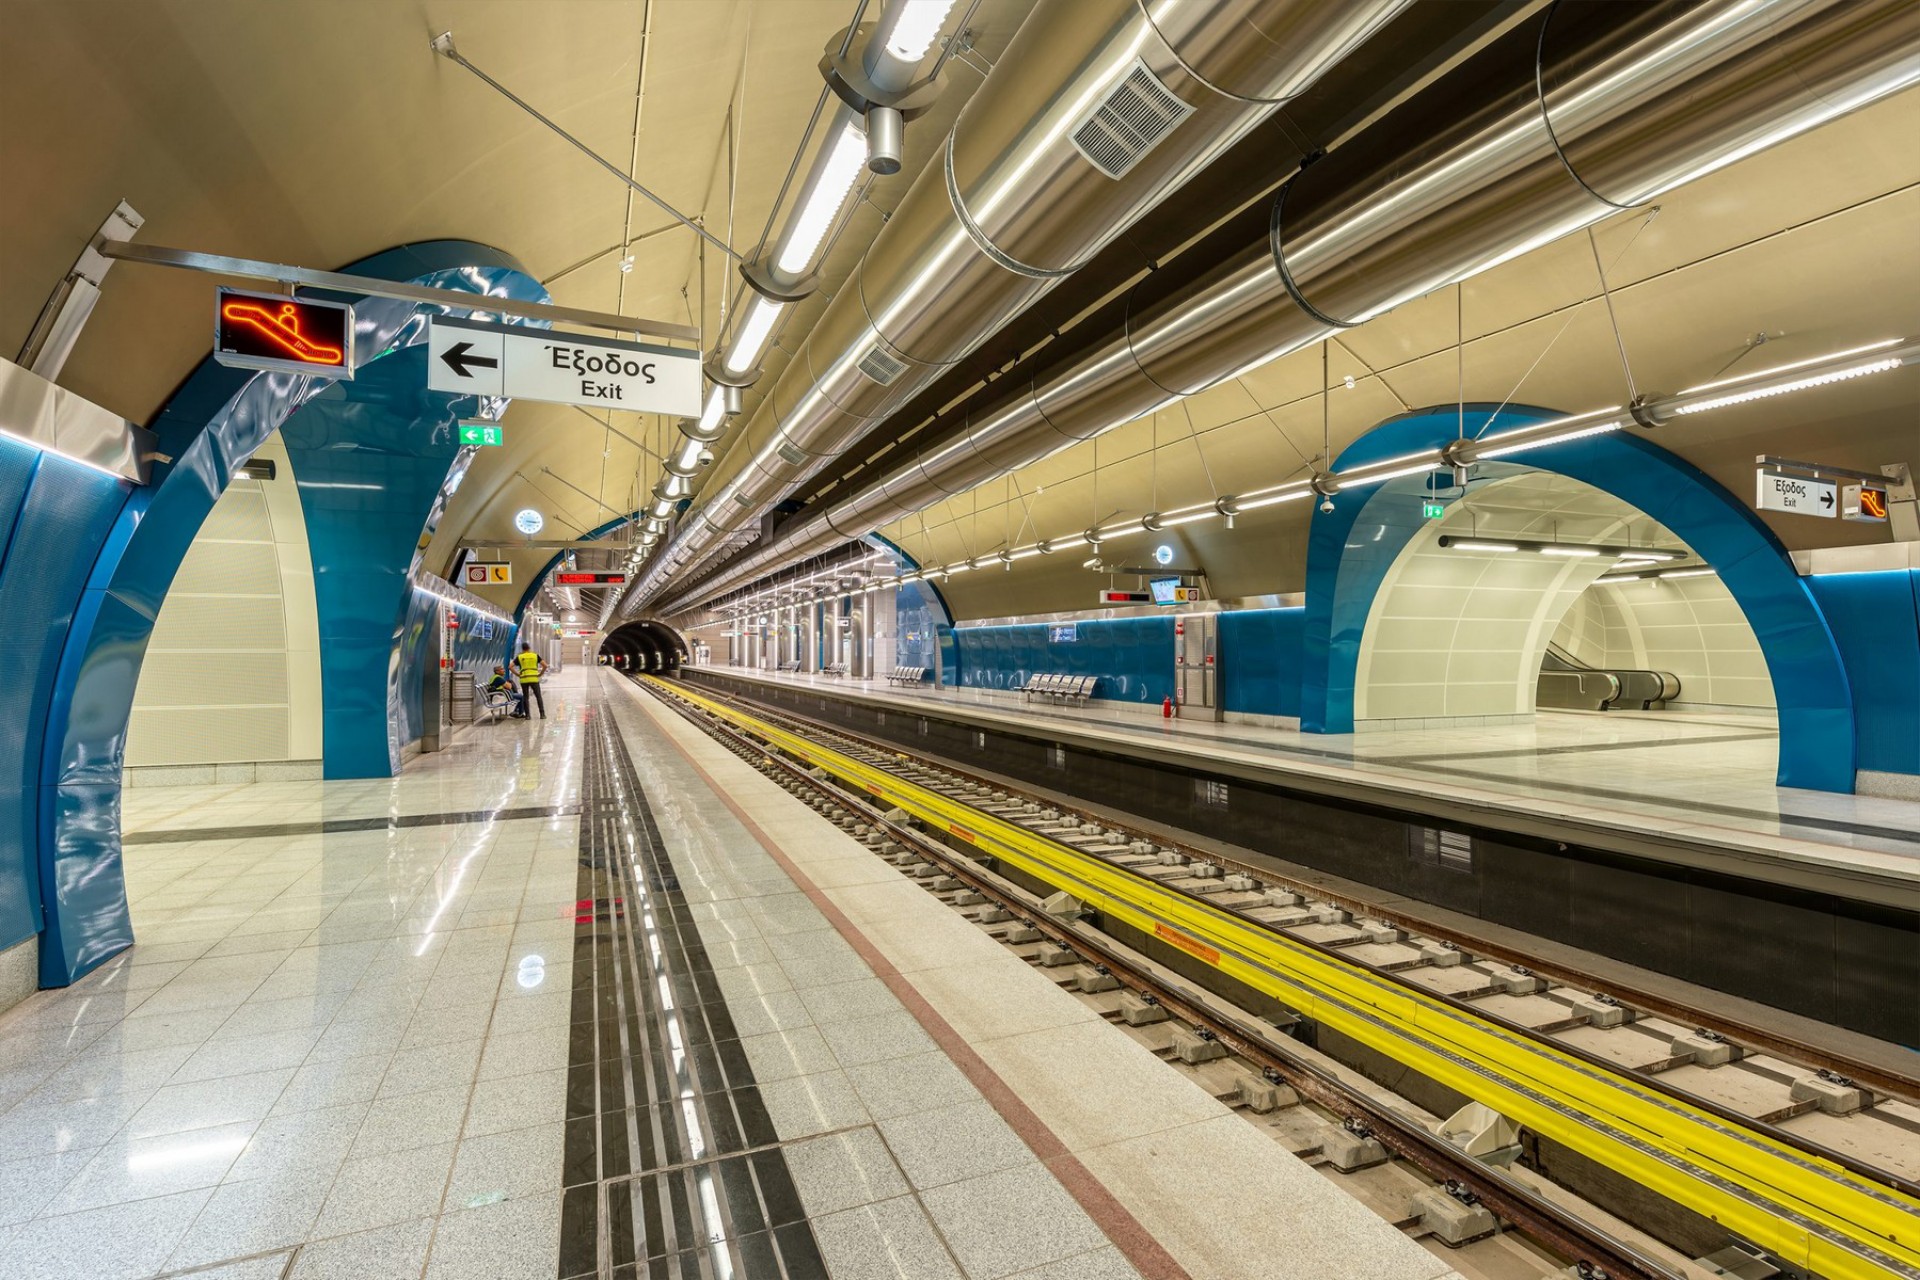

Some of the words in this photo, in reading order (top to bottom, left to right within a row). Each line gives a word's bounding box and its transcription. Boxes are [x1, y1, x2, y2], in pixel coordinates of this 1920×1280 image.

[544, 345, 656, 384] Έξοδος
[581, 380, 623, 400] Exit
[1774, 479, 1806, 498] Έξοδος
[1784, 496, 1797, 507] Exit
